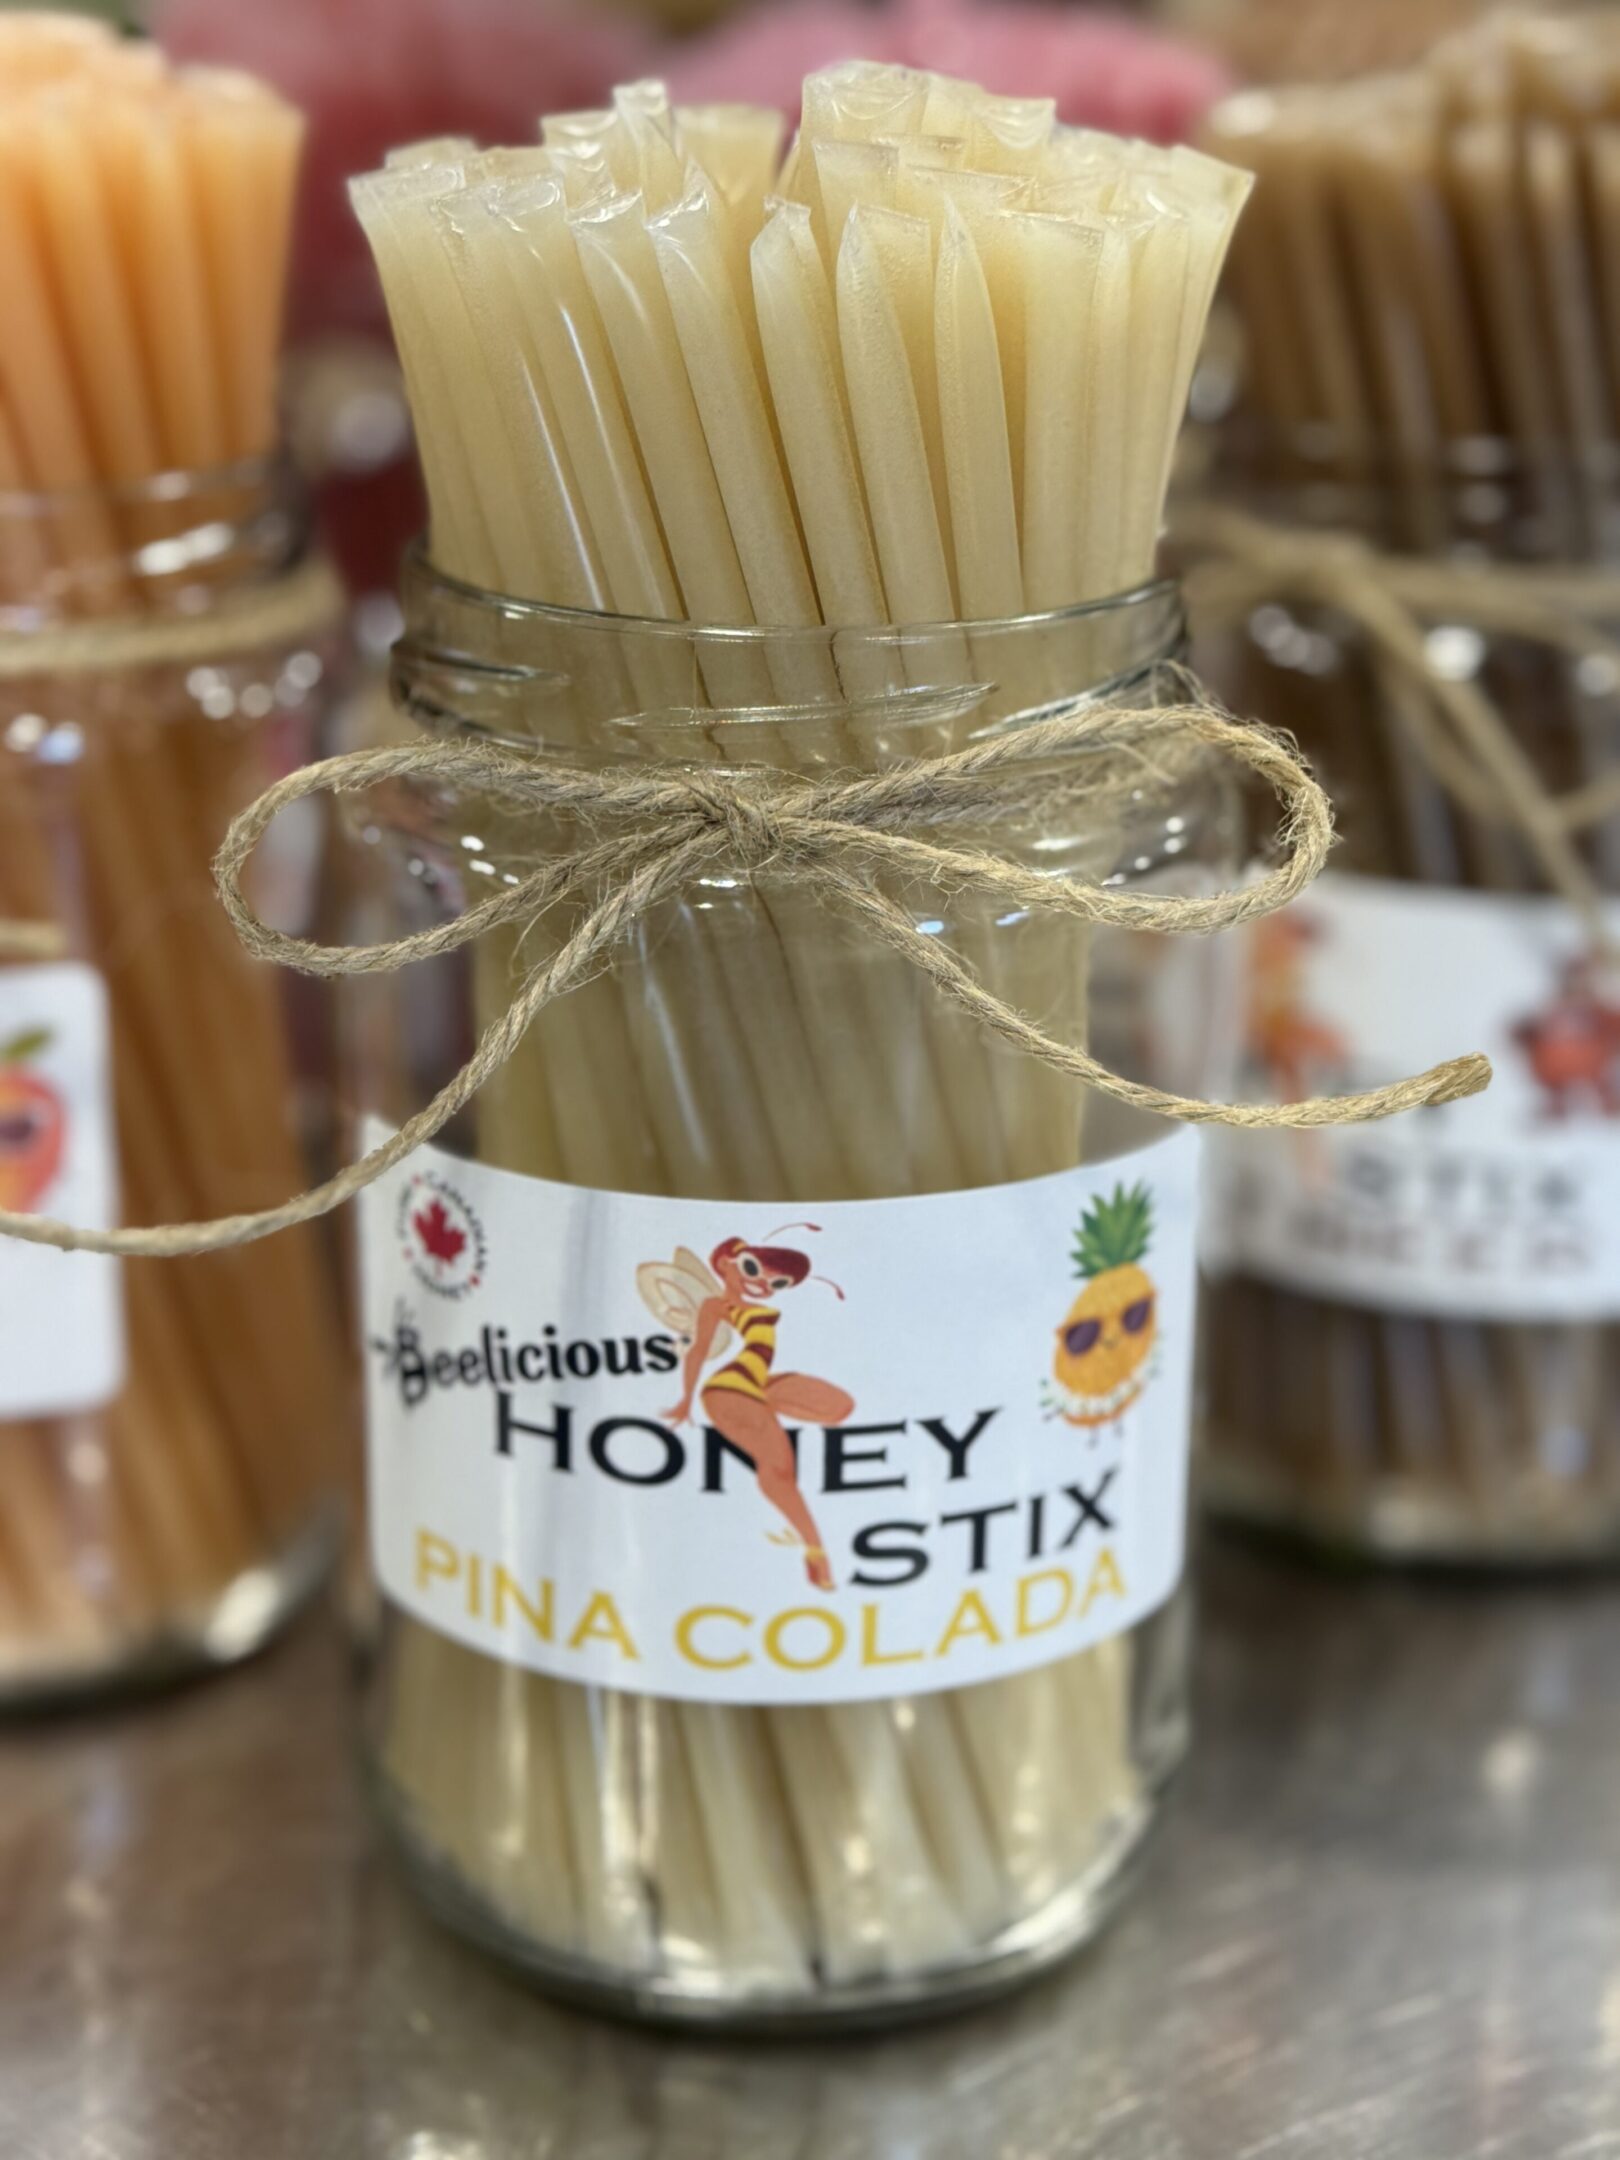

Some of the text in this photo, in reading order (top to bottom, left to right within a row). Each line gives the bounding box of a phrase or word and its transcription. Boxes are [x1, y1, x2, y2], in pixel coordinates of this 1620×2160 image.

[396, 1324, 679, 1407] Beelicious
[493, 1390, 1003, 1494] HONEY
[848, 1468, 1119, 1588] STIX
[413, 1526, 1128, 1673] PINA COLADA
